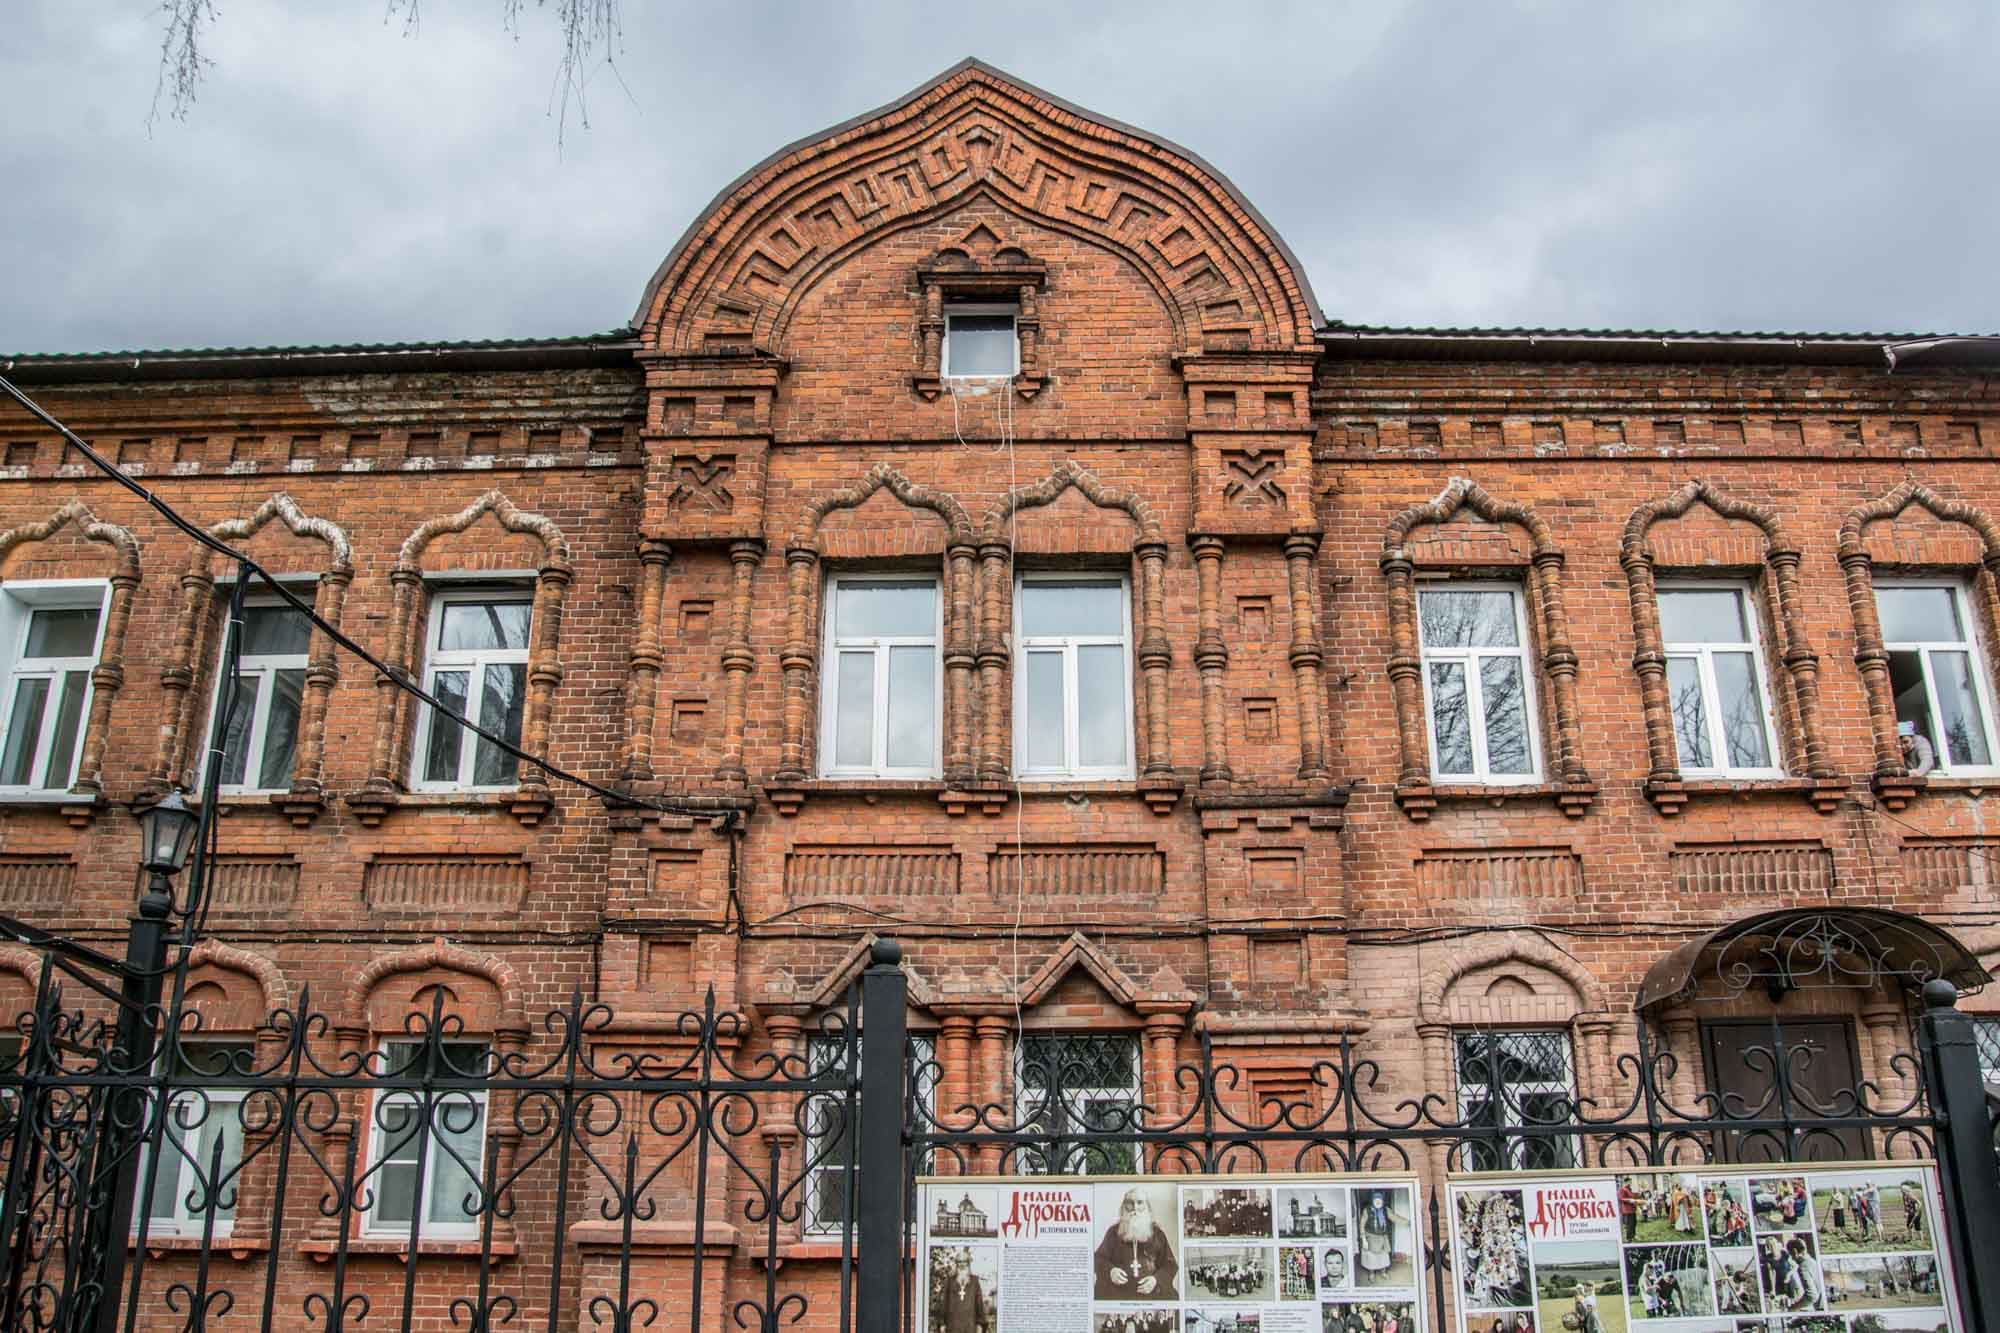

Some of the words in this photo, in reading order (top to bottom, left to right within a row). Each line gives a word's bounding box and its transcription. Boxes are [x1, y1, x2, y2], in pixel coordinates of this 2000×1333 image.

[1023, 1191, 1072, 1202] НАША
[1547, 1189, 1596, 1200] НАША
[1001, 1191, 1091, 1239] ДУРОВКА
[1528, 1190, 1616, 1238] ДУРОВКА
[1068, 1226, 1088, 1234] ХРАМА
